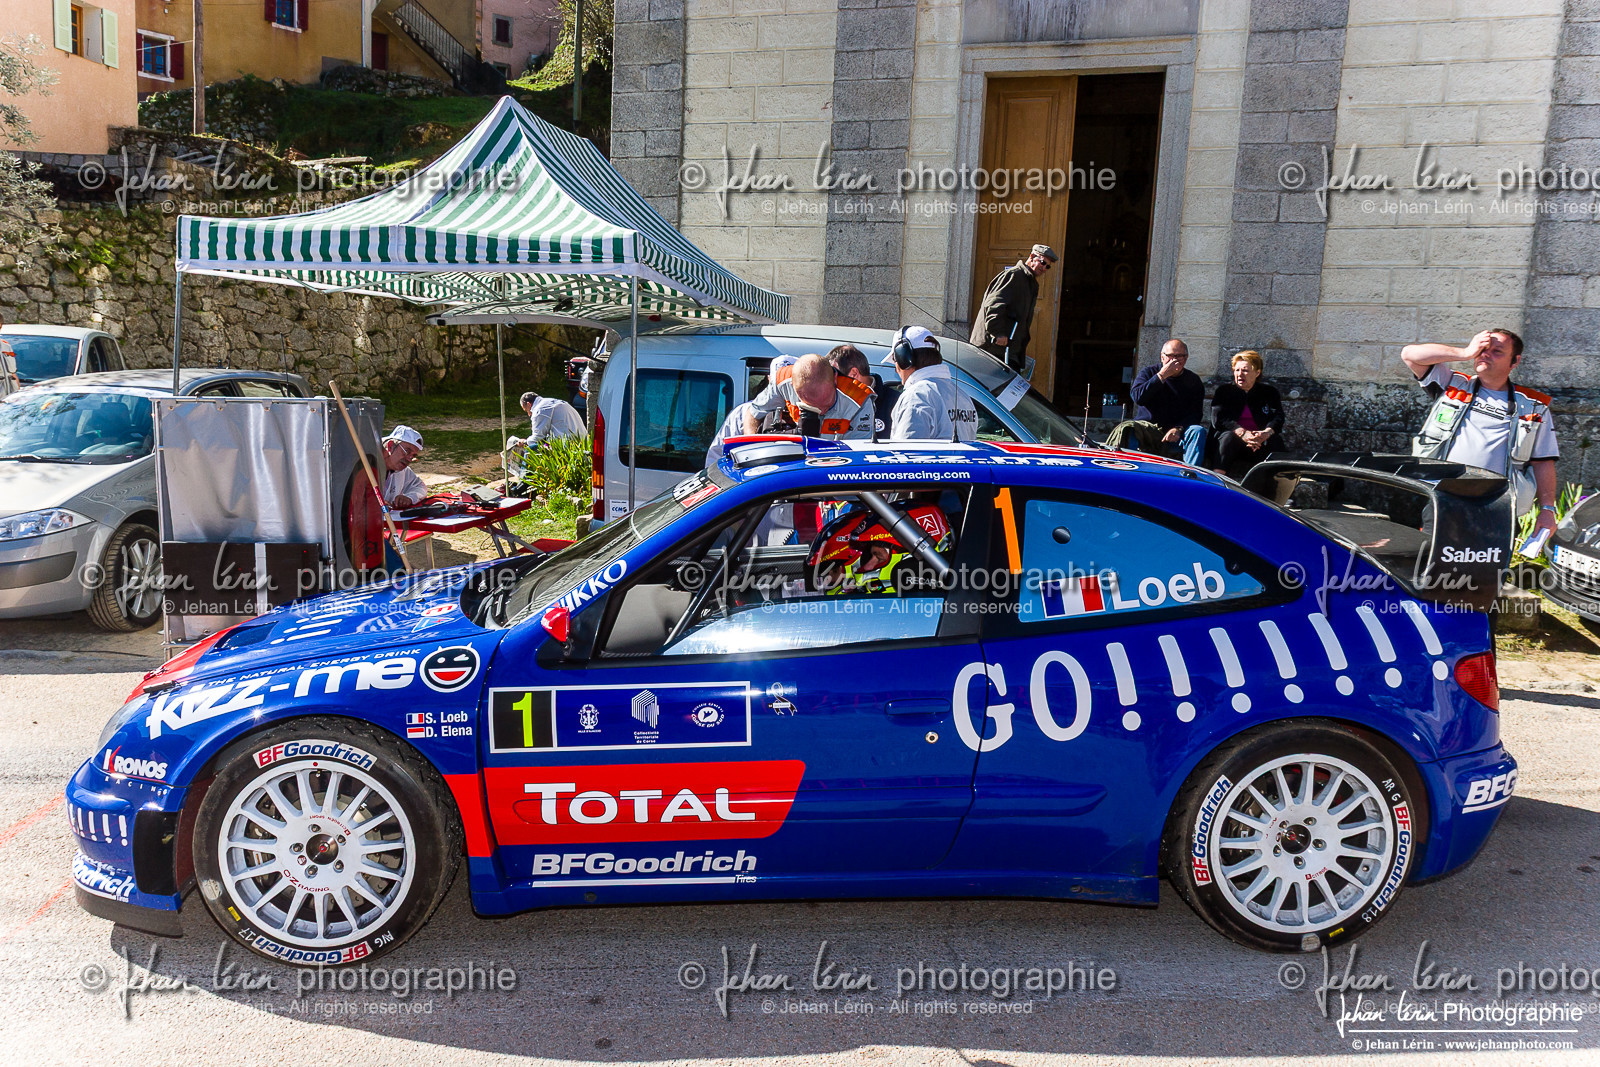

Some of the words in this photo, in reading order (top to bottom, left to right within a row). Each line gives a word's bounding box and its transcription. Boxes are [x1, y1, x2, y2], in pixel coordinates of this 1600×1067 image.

[828, 470, 970, 480] www.kronosracing.com
[993, 487, 1022, 575] 1
[1441, 546, 1502, 563] Sabelt
[1108, 562, 1226, 610] Loeb
[208, 677, 235, 686] THE
[239, 665, 304, 681] NATURAL
[309, 654, 371, 668] ENERGY
[374, 648, 422, 659] DRINK
[425, 713, 436, 724] S.
[440, 711, 468, 723] Loeb
[425, 727, 438, 738] D.
[441, 725, 473, 738] Elena
[512, 692, 534, 747] 1
[102, 745, 169, 780] KRONOS
[257, 741, 374, 769] BFGoodrich
[524, 782, 756, 825] TOTAL
[1192, 776, 1232, 883] BFGoodrich
[532, 850, 757, 875] BFGoodrich
[1376, 805, 1411, 909] BFGoodrich
[1361, 908, 1379, 923] 18
[238, 927, 254, 942] 17
[255, 936, 370, 966] BFGoodrich
